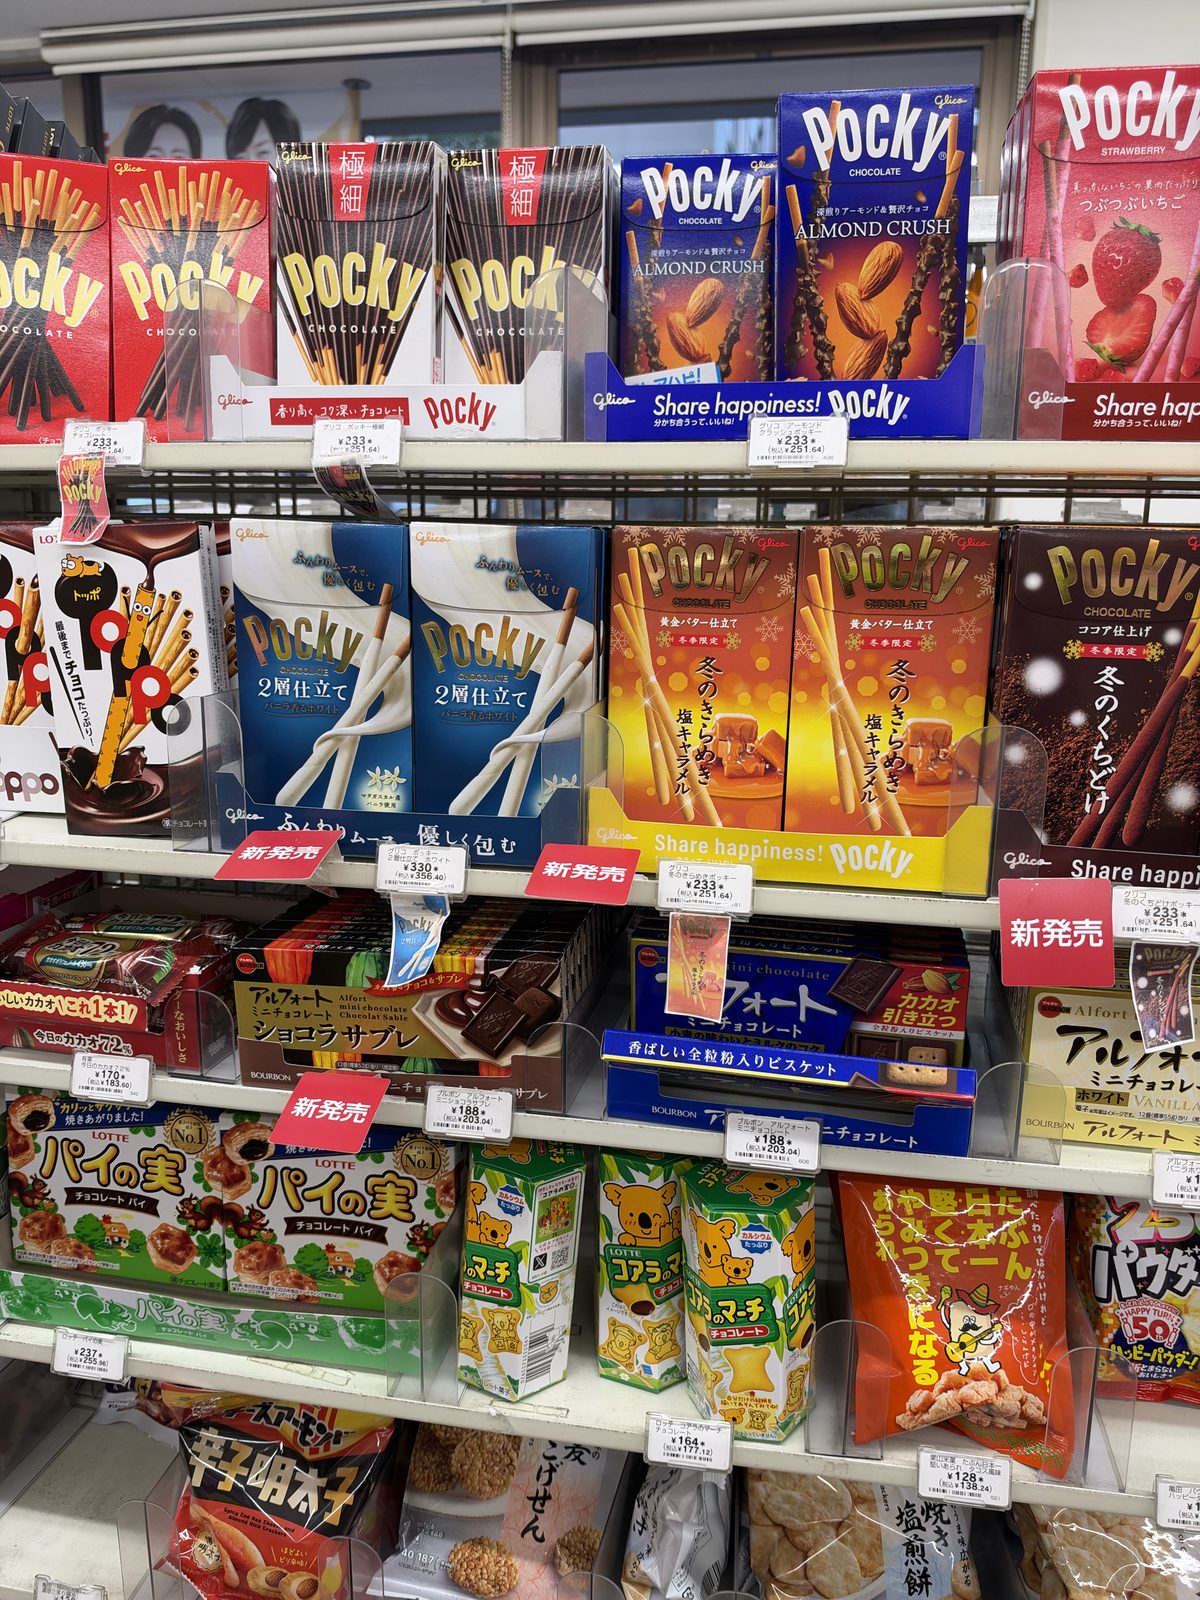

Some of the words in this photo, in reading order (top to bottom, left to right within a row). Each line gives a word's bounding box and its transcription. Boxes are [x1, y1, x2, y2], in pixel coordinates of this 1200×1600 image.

[934, 95, 969, 109] Glico
[802, 93, 950, 172] Pocky
[281, 150, 312, 163] Glico
[1101, 146, 1166, 158] STRAWBERRY
[115, 163, 147, 176] Glico
[451, 157, 482, 170] Glico
[849, 167, 902, 177] CHOCOLATE
[338, 150, 366, 214] 極細
[508, 156, 536, 218] 極細
[641, 158, 765, 223] Pocky
[1080, 194, 1186, 211] つぶつぶいちご
[678, 217, 723, 226] CHOCOLATE
[795, 222, 883, 241] ALMOND
[886, 218, 951, 236] CRUSH
[633, 260, 706, 277] ALMOND
[709, 259, 766, 275] CRUSH
[283, 241, 427, 323] Pocky
[308, 324, 397, 335] CHOCOLATE
[475, 328, 565, 338] CHOCOLATE
[218, 393, 253, 409] Glico
[593, 393, 636, 408] Glico
[653, 394, 709, 415] Share
[714, 392, 821, 416] happiness!
[828, 384, 911, 425] Pocky
[1028, 391, 1075, 409] Glico
[1093, 393, 1157, 416] Share
[360, 404, 404, 418] チョコレート
[423, 392, 497, 432] Pocky
[236, 528, 270, 543] Glico
[415, 531, 451, 546] Glico
[758, 537, 790, 551] Glico
[957, 537, 992, 552] Glico
[640, 535, 771, 605] Pocky
[831, 534, 971, 605] Pocky
[1047, 537, 1200, 612] Pocky
[73, 587, 101, 603] トッポ
[672, 598, 731, 610] CHOCOLATE
[864, 598, 926, 611] CHOCOLATE
[1083, 606, 1151, 619] CHOCOLATE
[658, 616, 738, 631] 黄金バター仕立て
[849, 617, 933, 633] 黄金バター仕立て
[1078, 624, 1153, 638] ココア仕上げ
[242, 610, 365, 674] Pocky
[420, 615, 547, 681] Pocky
[677, 635, 720, 647] 冬季限定
[868, 637, 913, 649] 冬季限定
[1090, 644, 1137, 658] 冬季限定
[280, 666, 329, 677] CHOCOLATE
[458, 673, 508, 684] CHOCOLATE
[258, 677, 348, 702] 2層仕立て
[435, 684, 528, 708] 2層仕立て
[694, 655, 723, 788] 冬のきらめき
[883, 659, 917, 796] 冬のきらめき
[1085, 664, 1124, 815] 冬のくちどけ
[675, 708, 704, 798] 塩キャラメル
[860, 714, 883, 806] 塩キャラメル
[225, 808, 265, 823] Glico
[238, 844, 323, 861] 新発売
[417, 827, 517, 862] 優しく包む
[655, 833, 709, 855] Share
[714, 836, 824, 863] happiness!
[830, 839, 914, 879] Pocky
[1003, 852, 1052, 869] Glico
[542, 861, 628, 883] 新発売
[1071, 858, 1133, 882] Share
[1010, 917, 1104, 949] 新発売
[756, 963, 830, 982] chocolate
[248, 986, 333, 1008] アルフォート
[339, 993, 367, 1003] Alfort
[899, 993, 960, 1011] カカオ
[252, 1006, 333, 1021] ミニチョコレート
[362, 1004, 408, 1014] chocolate
[340, 1011, 382, 1021] Chocolat
[383, 1012, 409, 1022] Sable
[882, 1008, 956, 1029] 引き立つ
[1075, 1004, 1127, 1020] Alfort
[252, 1020, 421, 1050] ショコラサブレ
[250, 1072, 292, 1082] BOURBON
[1076, 1088, 1125, 1104] ホワイト
[1133, 1093, 1200, 1113] VANILLA
[65, 1110, 145, 1127] 焼きあがりました!
[290, 1096, 371, 1125] 新発売
[651, 1105, 697, 1119] BOURBON
[1026, 1118, 1075, 1131] BOURBON
[1083, 1120, 1184, 1144] アルフォート
[92, 1131, 129, 1143] LOTTE
[174, 1127, 206, 1146] No.1
[39, 1135, 188, 1197] パイの実
[315, 1159, 356, 1171] LOTTE
[404, 1154, 439, 1171] No.1
[75, 1191, 124, 1206] チョコレート
[128, 1198, 147, 1210] パイ
[257, 1164, 419, 1224] パイの実
[498, 1190, 524, 1206] カルシウム
[499, 1200, 521, 1213] たっぷり
[296, 1221, 350, 1234] チョコレート
[354, 1226, 374, 1238] パイ
[872, 1187, 900, 1263] あられ
[928, 1188, 961, 1274] 堅くて
[964, 1188, 998, 1268] 日本一
[741, 1231, 772, 1242] カルシウム
[995, 1187, 1032, 1282] たぶん
[609, 1249, 642, 1259] LOTTE
[744, 1241, 769, 1251] たっぷり
[897, 1187, 940, 1385] やみつきになる
[688, 1279, 767, 1326] コアラのマーチ
[135, 1297, 229, 1335] パイの実
[1125, 1307, 1151, 1319] HAPPY
[1153, 1307, 1176, 1322] TURN
[711, 1327, 765, 1340] チョコレート
[1132, 1316, 1171, 1341] 50
[1109, 1343, 1199, 1370] ハッピーパウダー!
[188, 1427, 360, 1527] 辛子明太子
[520, 1440, 562, 1544] こげせん
[895, 1500, 933, 1599] 塩煎餅
